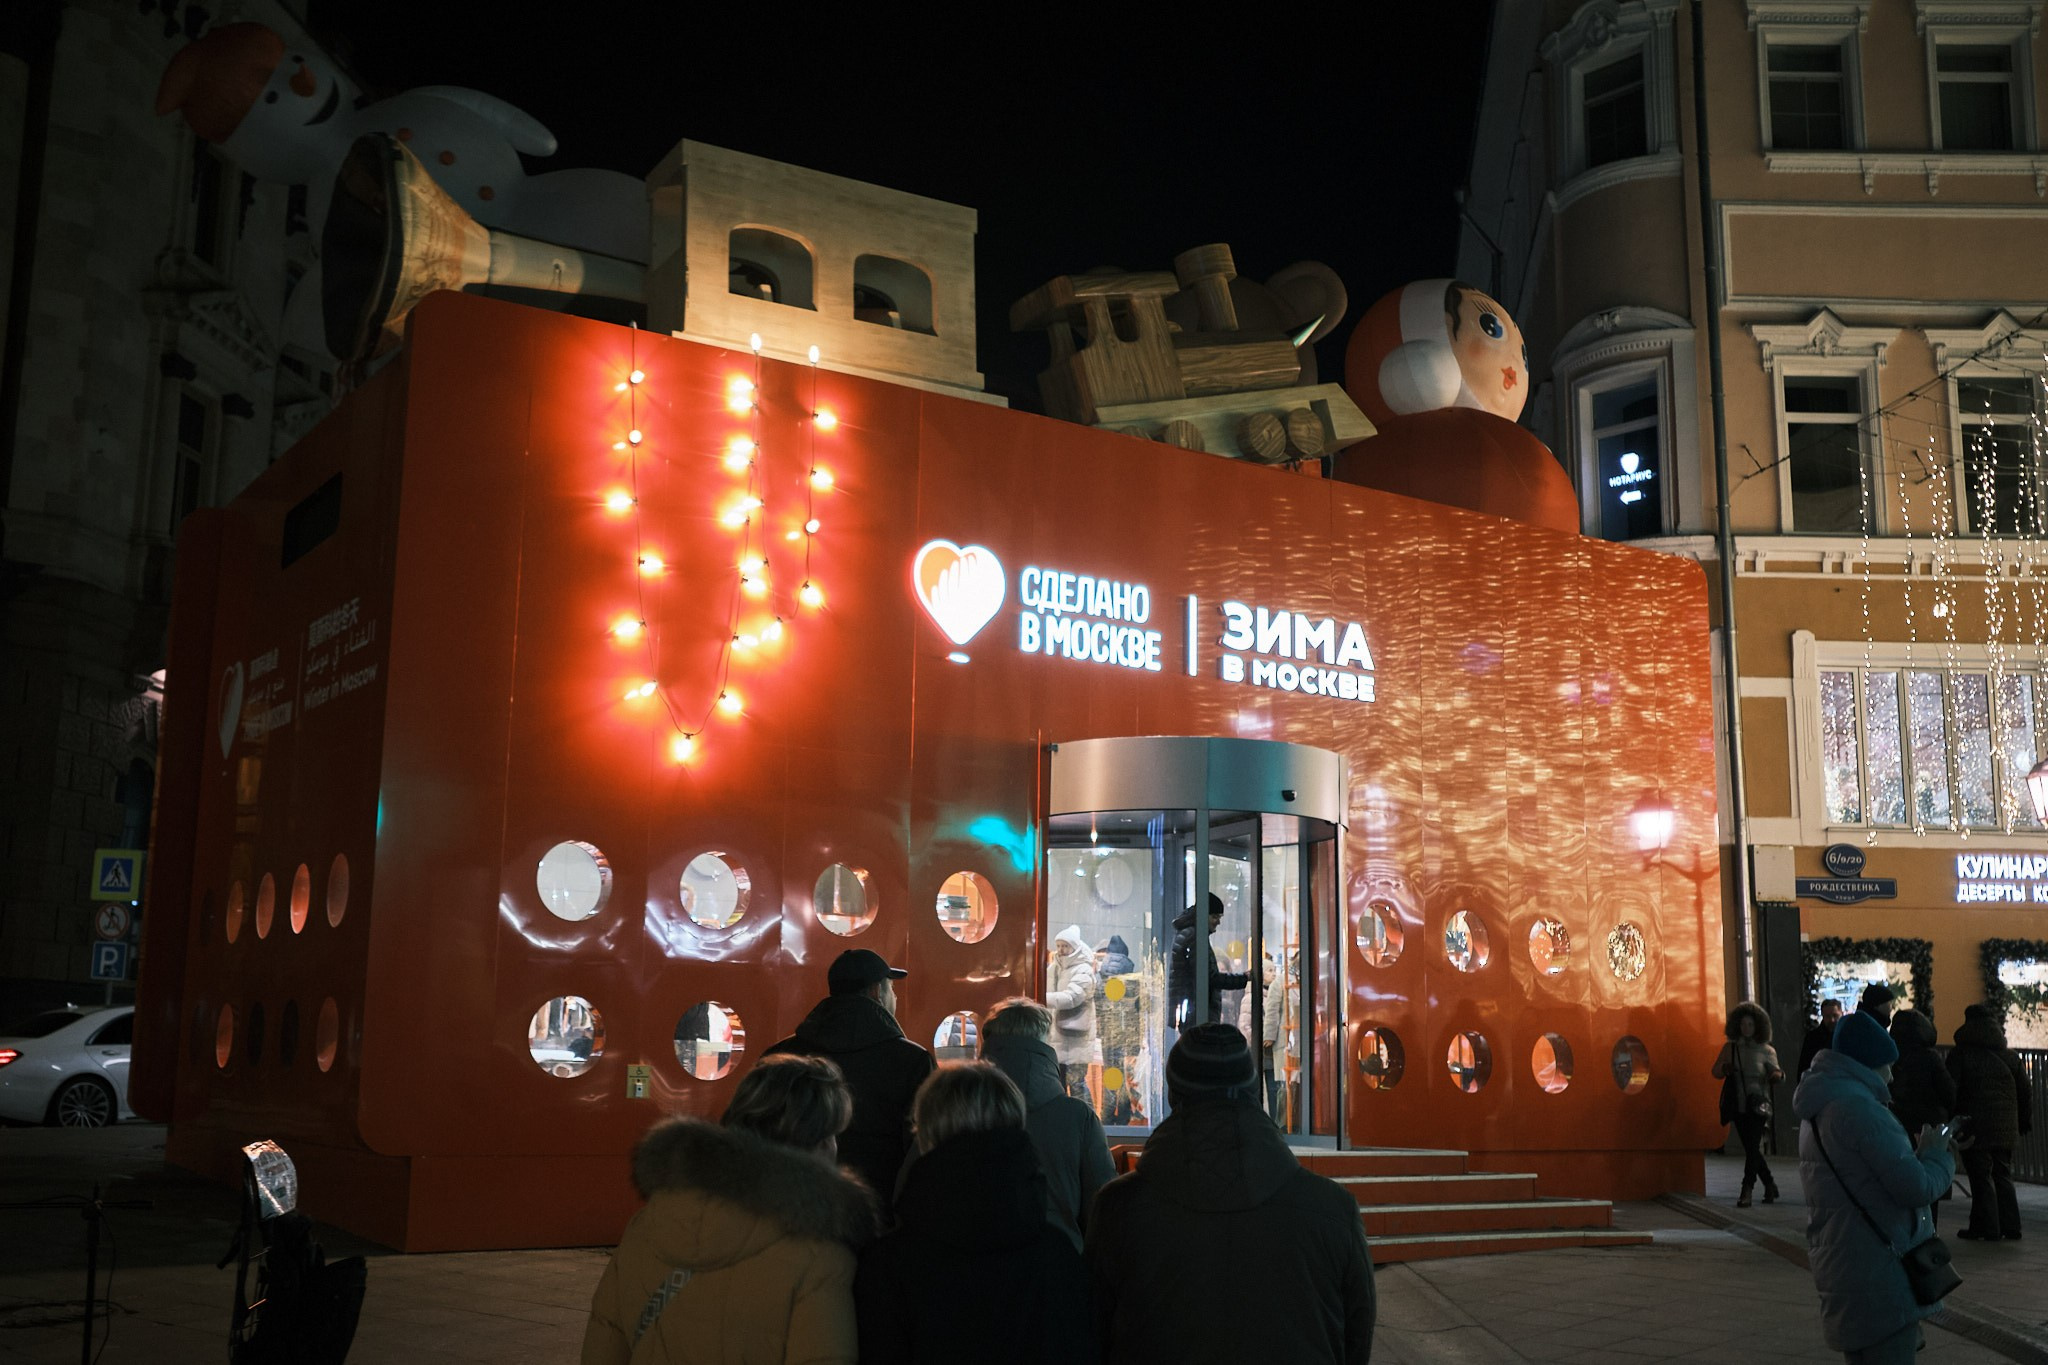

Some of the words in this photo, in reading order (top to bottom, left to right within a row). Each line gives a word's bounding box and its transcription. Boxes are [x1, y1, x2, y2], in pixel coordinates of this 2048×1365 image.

[1608, 468, 1652, 487] НОТАРИУС
[1020, 566, 1150, 624] СДЕЛАНО
[1020, 611, 1041, 653] В
[1045, 614, 1162, 672] МОСКВЕ
[1222, 600, 1376, 671] ЗИМА
[1222, 653, 1245, 683] В
[1252, 657, 1376, 703] МОСКВЕ
[1809, 882, 1880, 892] РОЖДЕСТВЕНКА
[1956, 883, 2026, 903] ДЕСЕРТЫ
